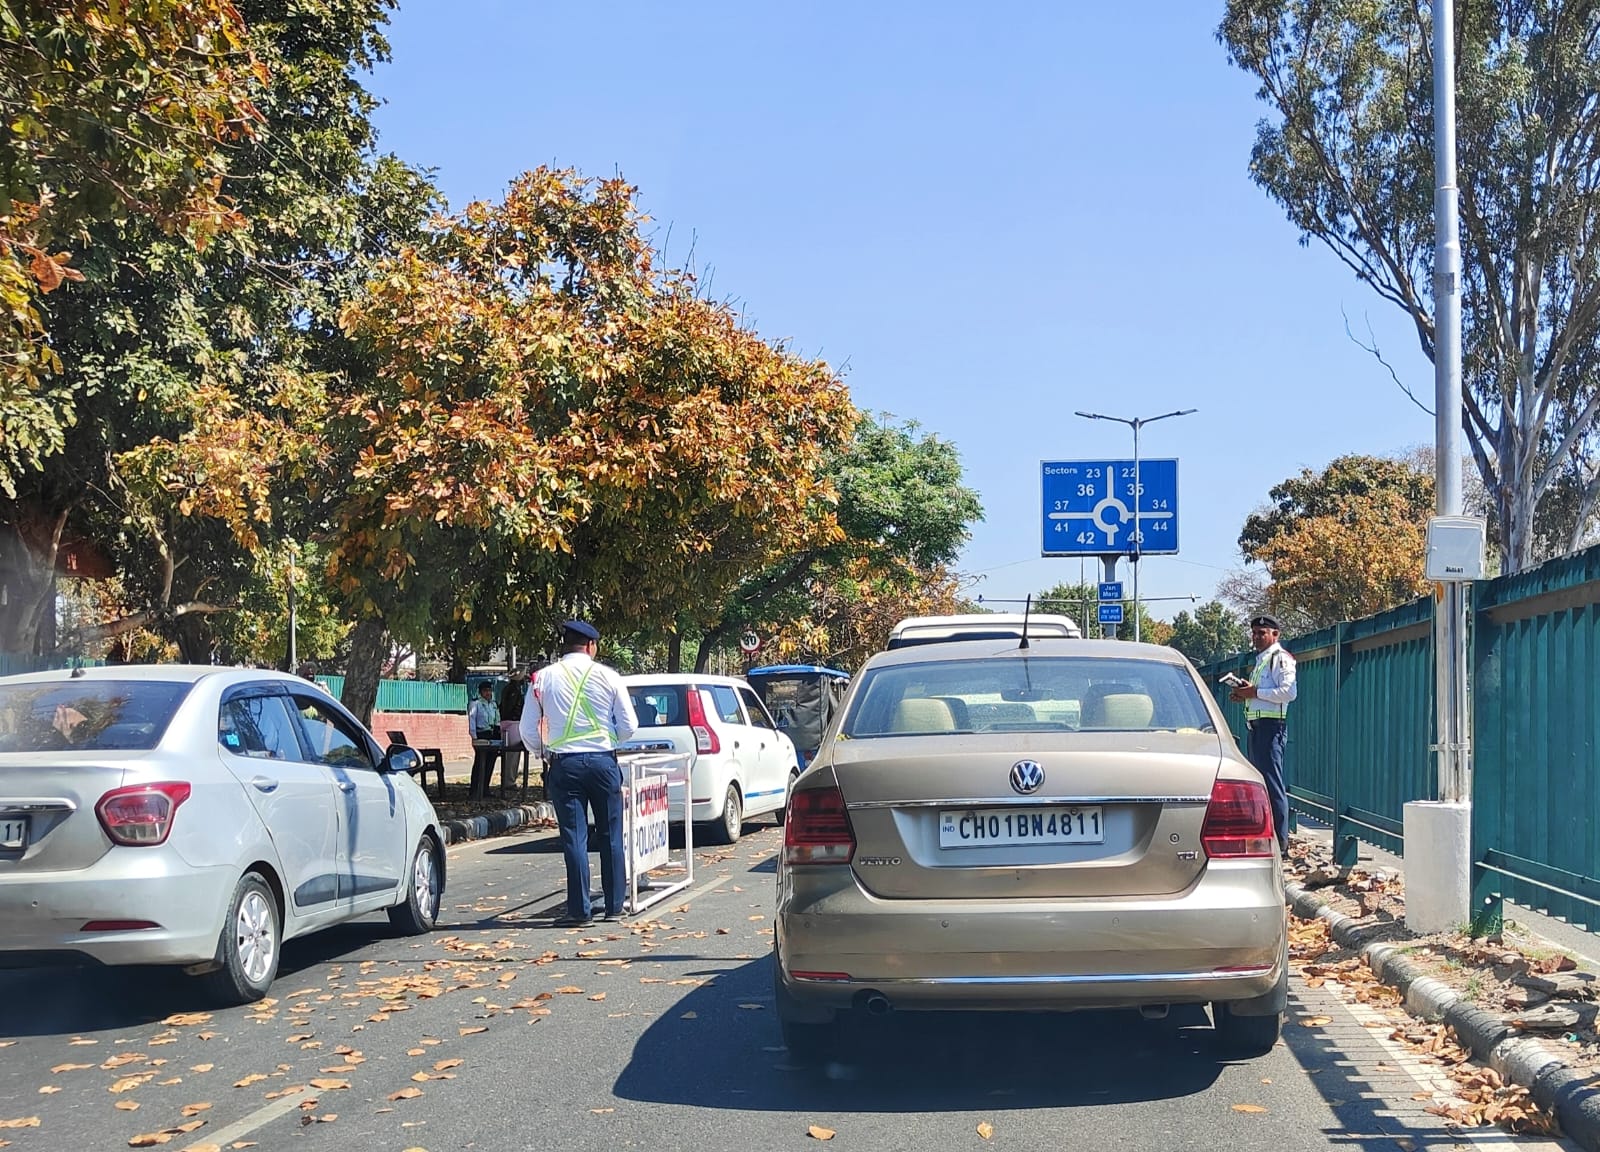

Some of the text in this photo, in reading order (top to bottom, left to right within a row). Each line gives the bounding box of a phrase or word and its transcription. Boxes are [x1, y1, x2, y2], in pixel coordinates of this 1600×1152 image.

[1044, 466, 1078, 475] Sectors
[1086, 468, 1101, 479] 23
[1121, 467, 1137, 478] 22
[1077, 483, 1095, 497] 36
[1126, 483, 1145, 496] 35
[1054, 500, 1069, 511] 37
[1152, 499, 1168, 510] 34
[1054, 522, 1069, 533] 41
[1152, 521, 1168, 532] 44
[1076, 531, 1095, 545] 42
[1102, 591, 1119, 599] Marg
[942, 825, 955, 833] IND
[959, 811, 1100, 839] CH01BN4811
